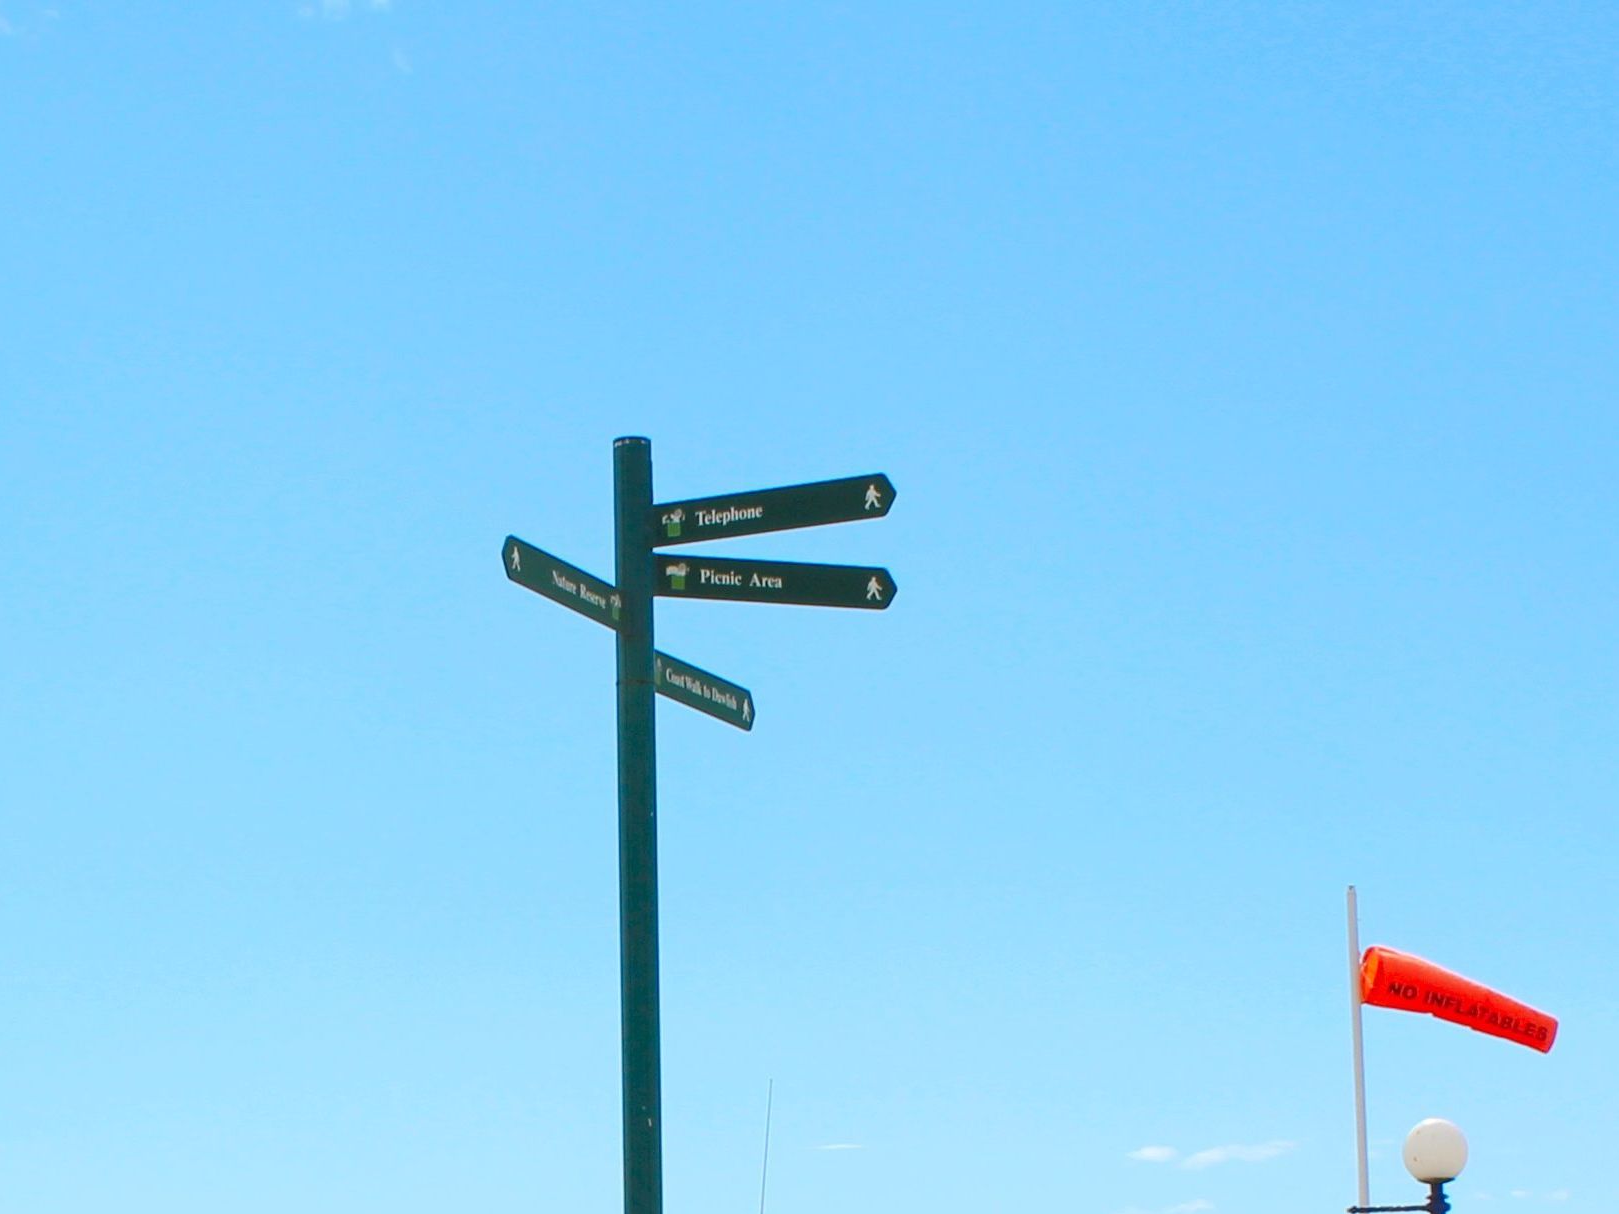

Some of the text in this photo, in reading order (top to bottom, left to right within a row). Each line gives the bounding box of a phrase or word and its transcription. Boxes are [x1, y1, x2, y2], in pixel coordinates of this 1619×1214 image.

[695, 505, 763, 527] Telephone
[700, 570, 783, 589] Picnic Area
[1389, 982, 1549, 1042] NO INFLATABLES
